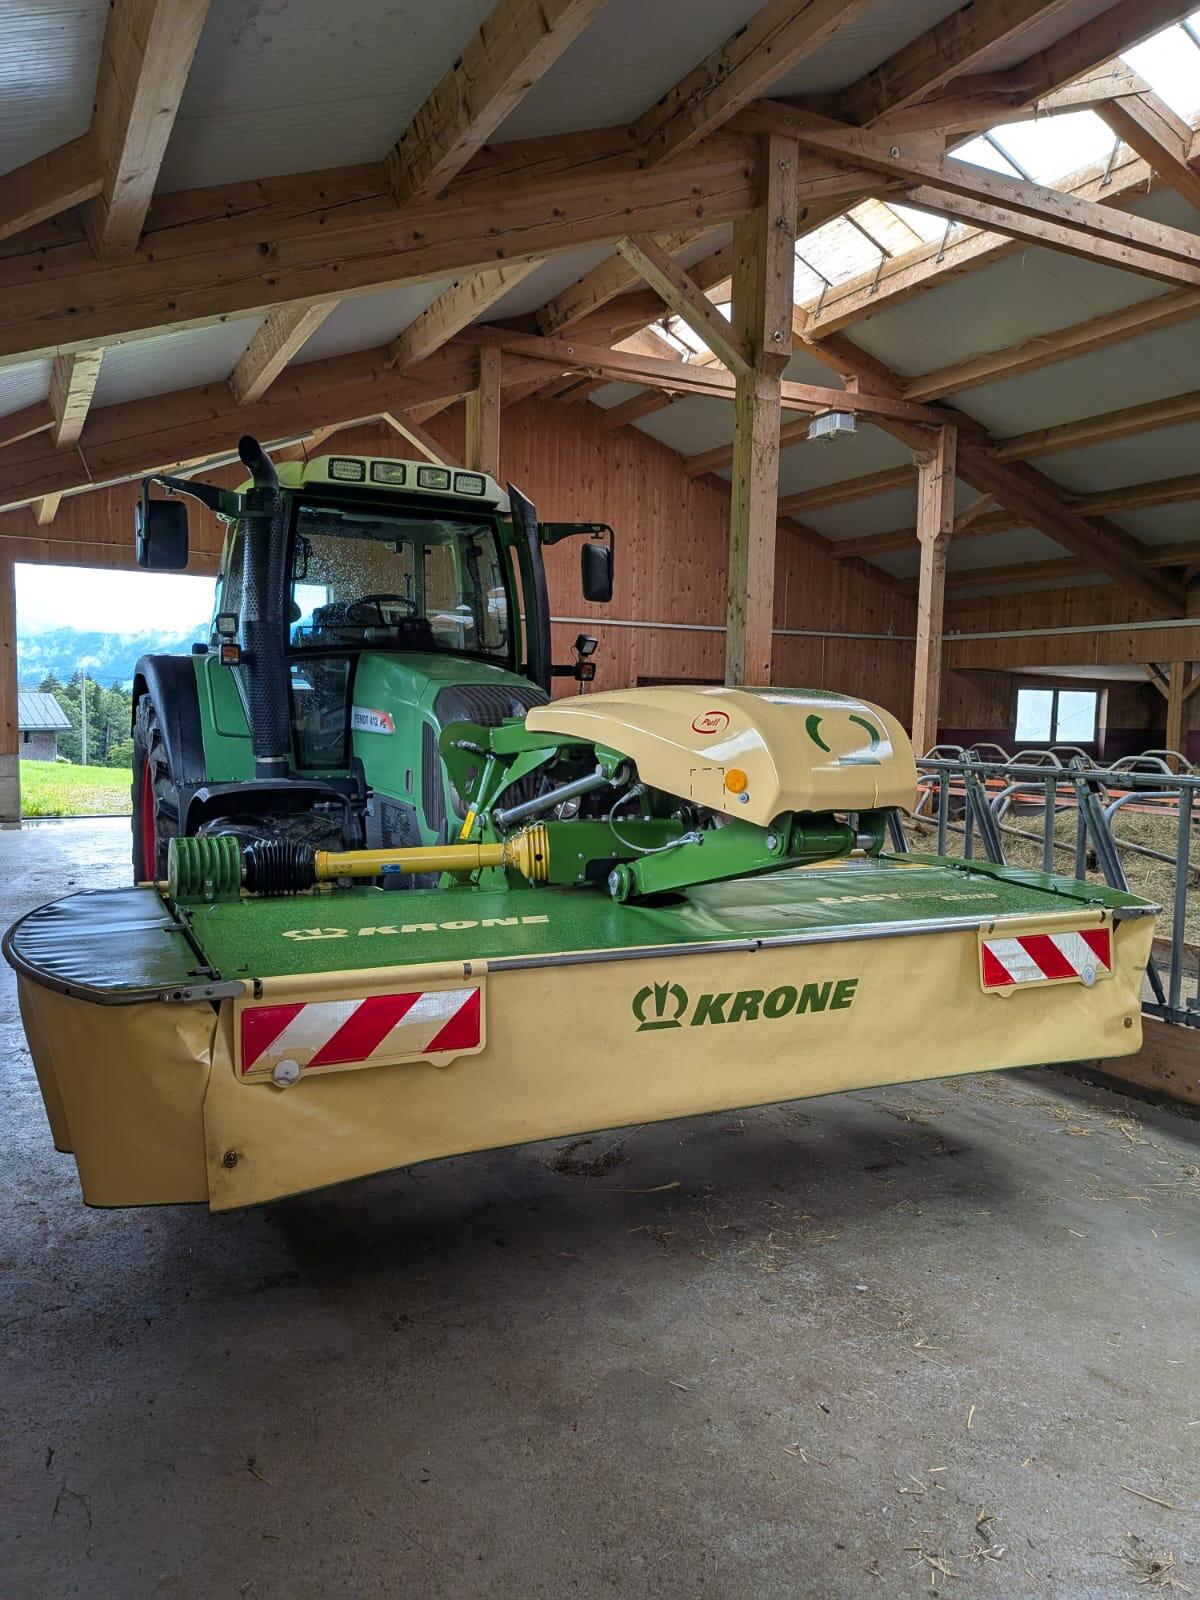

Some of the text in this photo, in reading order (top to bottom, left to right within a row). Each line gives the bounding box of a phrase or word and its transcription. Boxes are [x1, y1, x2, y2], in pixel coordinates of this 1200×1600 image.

[701, 718, 721, 727] Pull
[356, 915, 550, 936] KRONE
[690, 978, 859, 1026] KRONE
